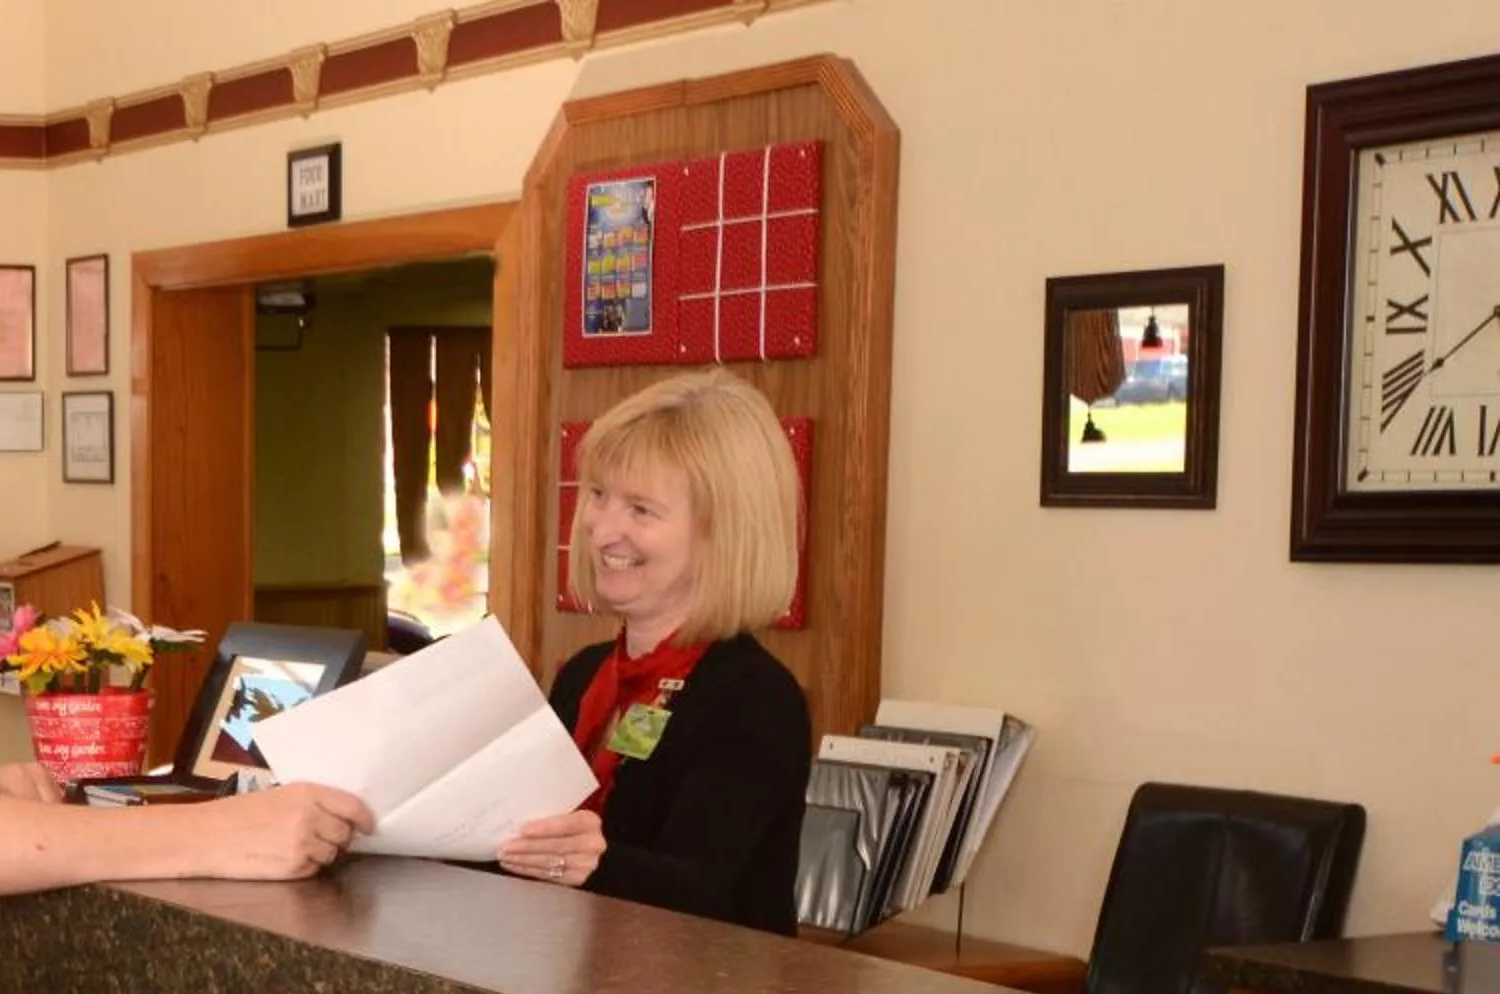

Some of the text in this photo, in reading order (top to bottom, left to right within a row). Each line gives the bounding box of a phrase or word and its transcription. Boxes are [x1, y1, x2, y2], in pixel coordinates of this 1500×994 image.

[1426, 171, 1476, 224] XI
[1389, 216, 1432, 278] X
[1386, 294, 1429, 335] IX
[1380, 348, 1425, 433] VIII
[1410, 405, 1456, 457] VII
